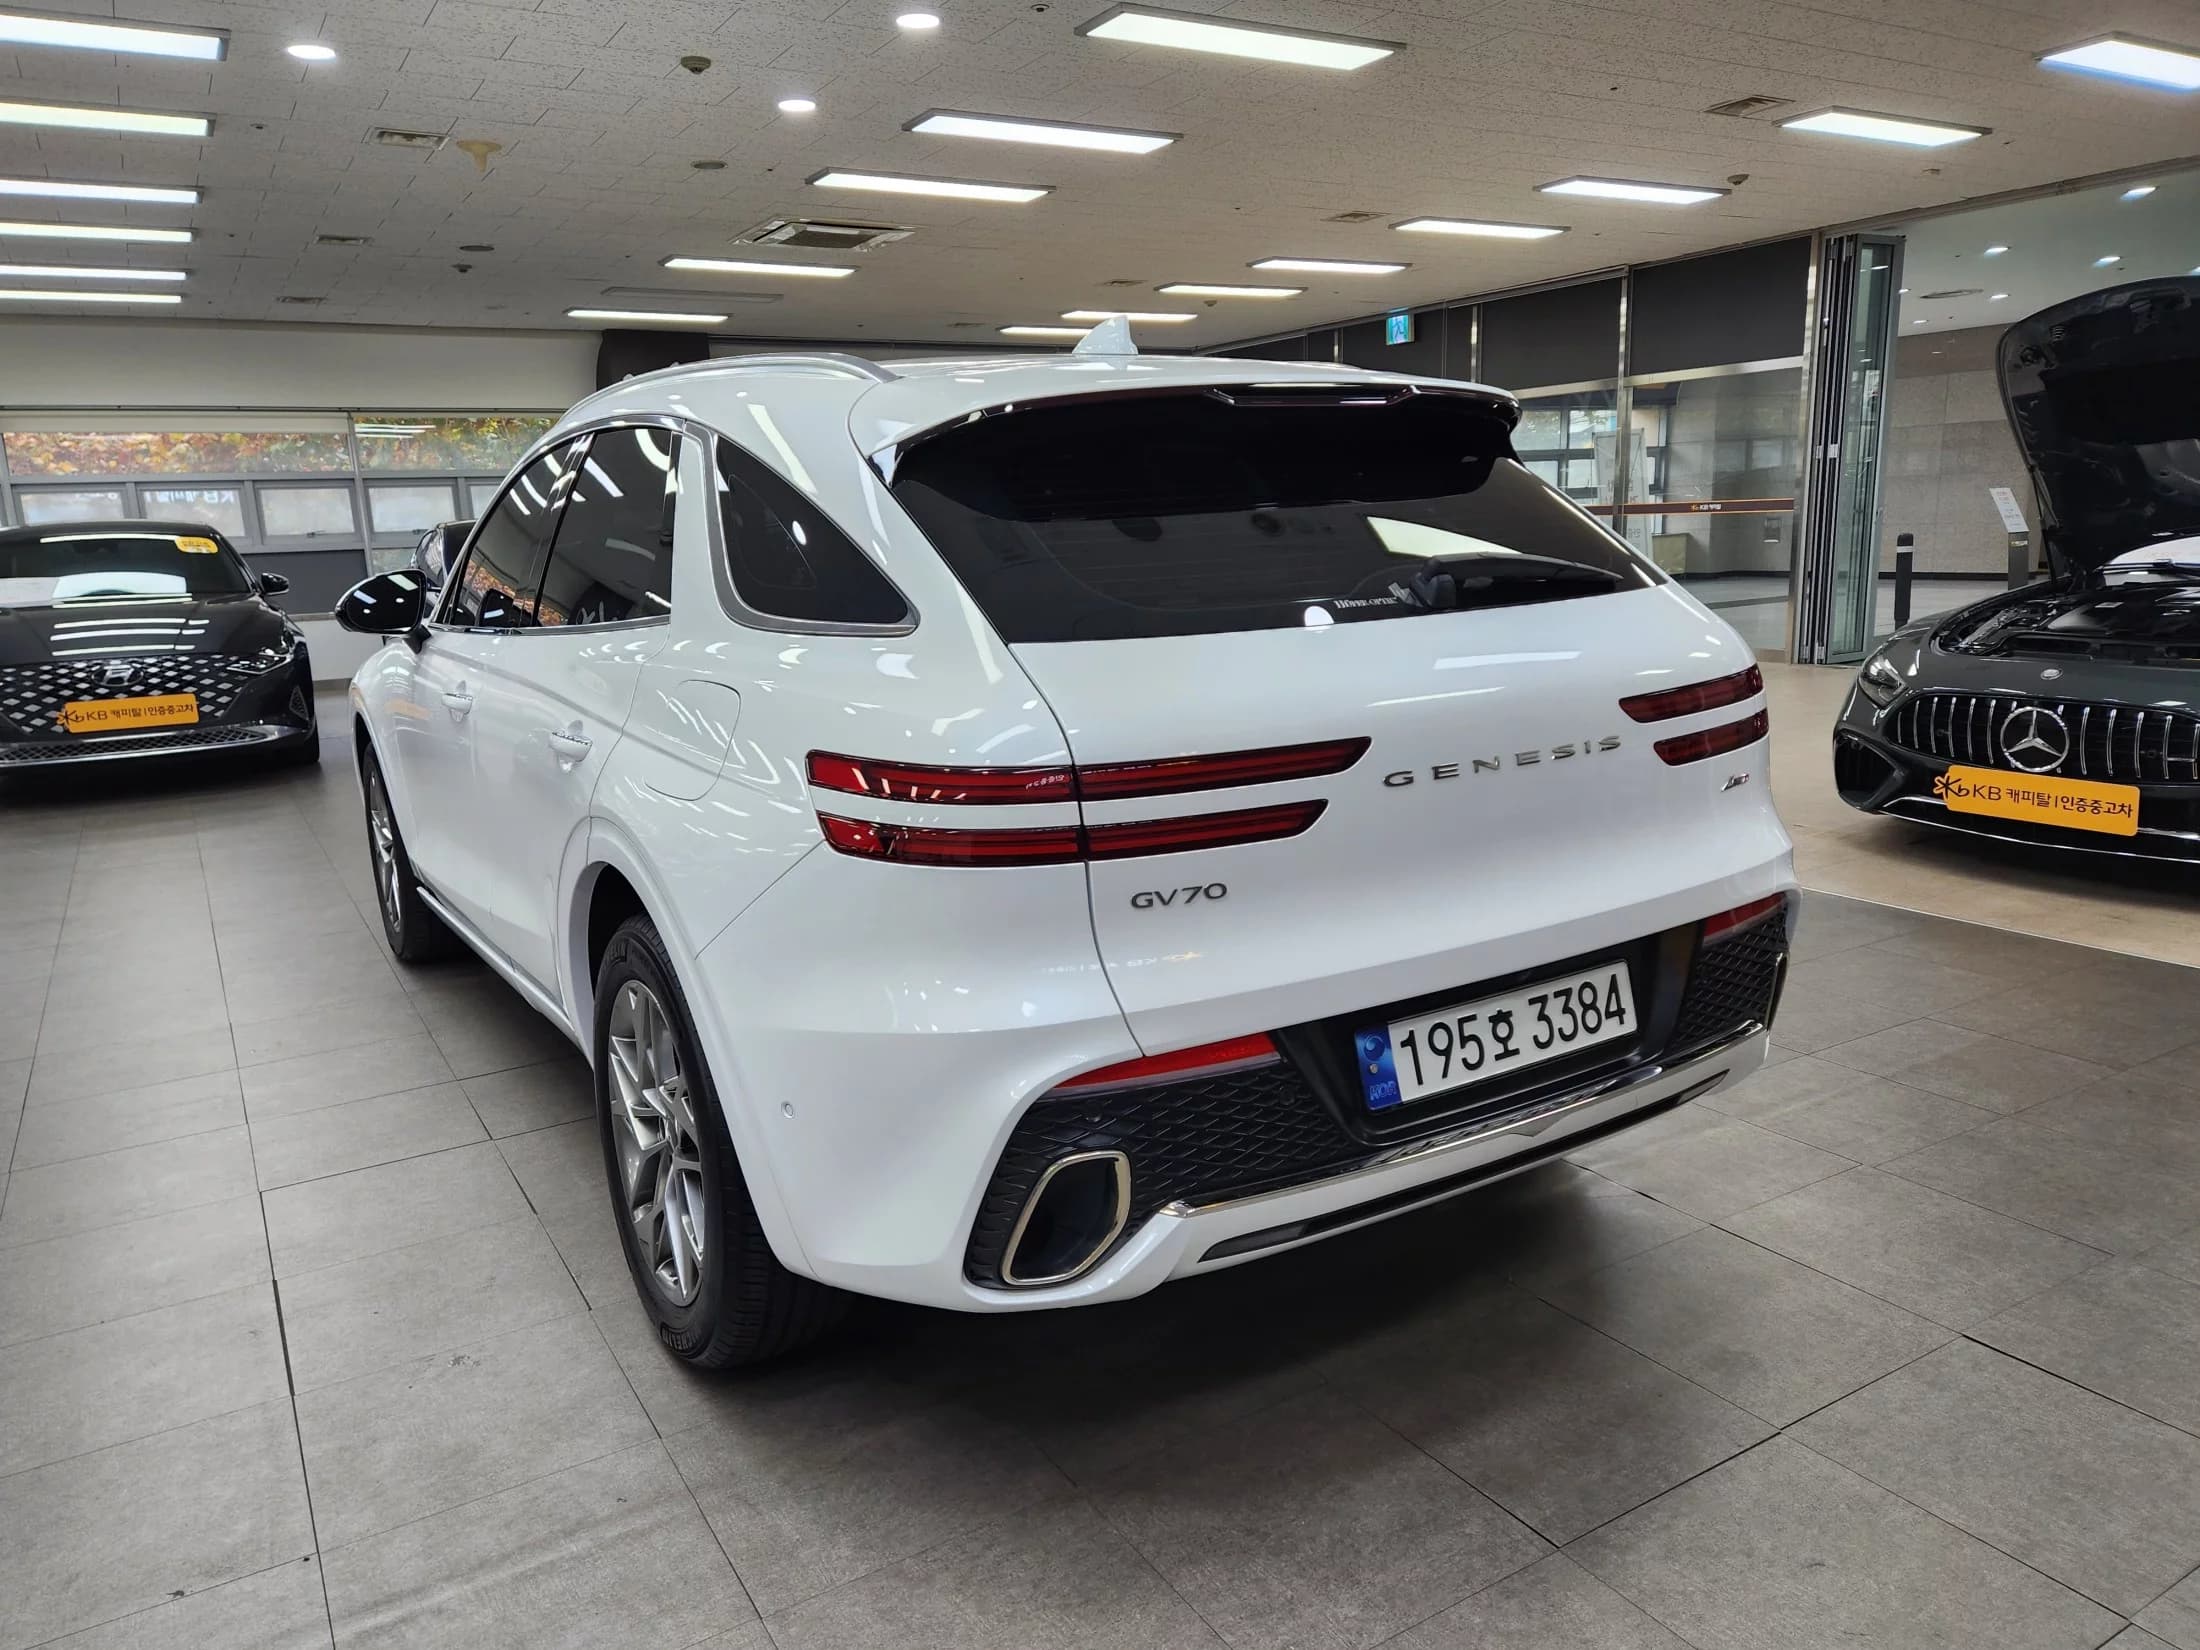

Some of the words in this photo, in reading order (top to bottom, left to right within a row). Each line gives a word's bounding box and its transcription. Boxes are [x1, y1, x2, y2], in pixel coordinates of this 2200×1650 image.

[86, 711, 108, 721] KB
[1383, 736, 1621, 787] GENESIS
[1972, 784, 2002, 801] KB
[2006, 788, 2051, 808] 캐피탈
[2060, 796, 2134, 818] 인증중고차
[1131, 883, 1228, 909] GV70
[1400, 1009, 1520, 1086] 195호
[1528, 974, 1626, 1050] 3384
